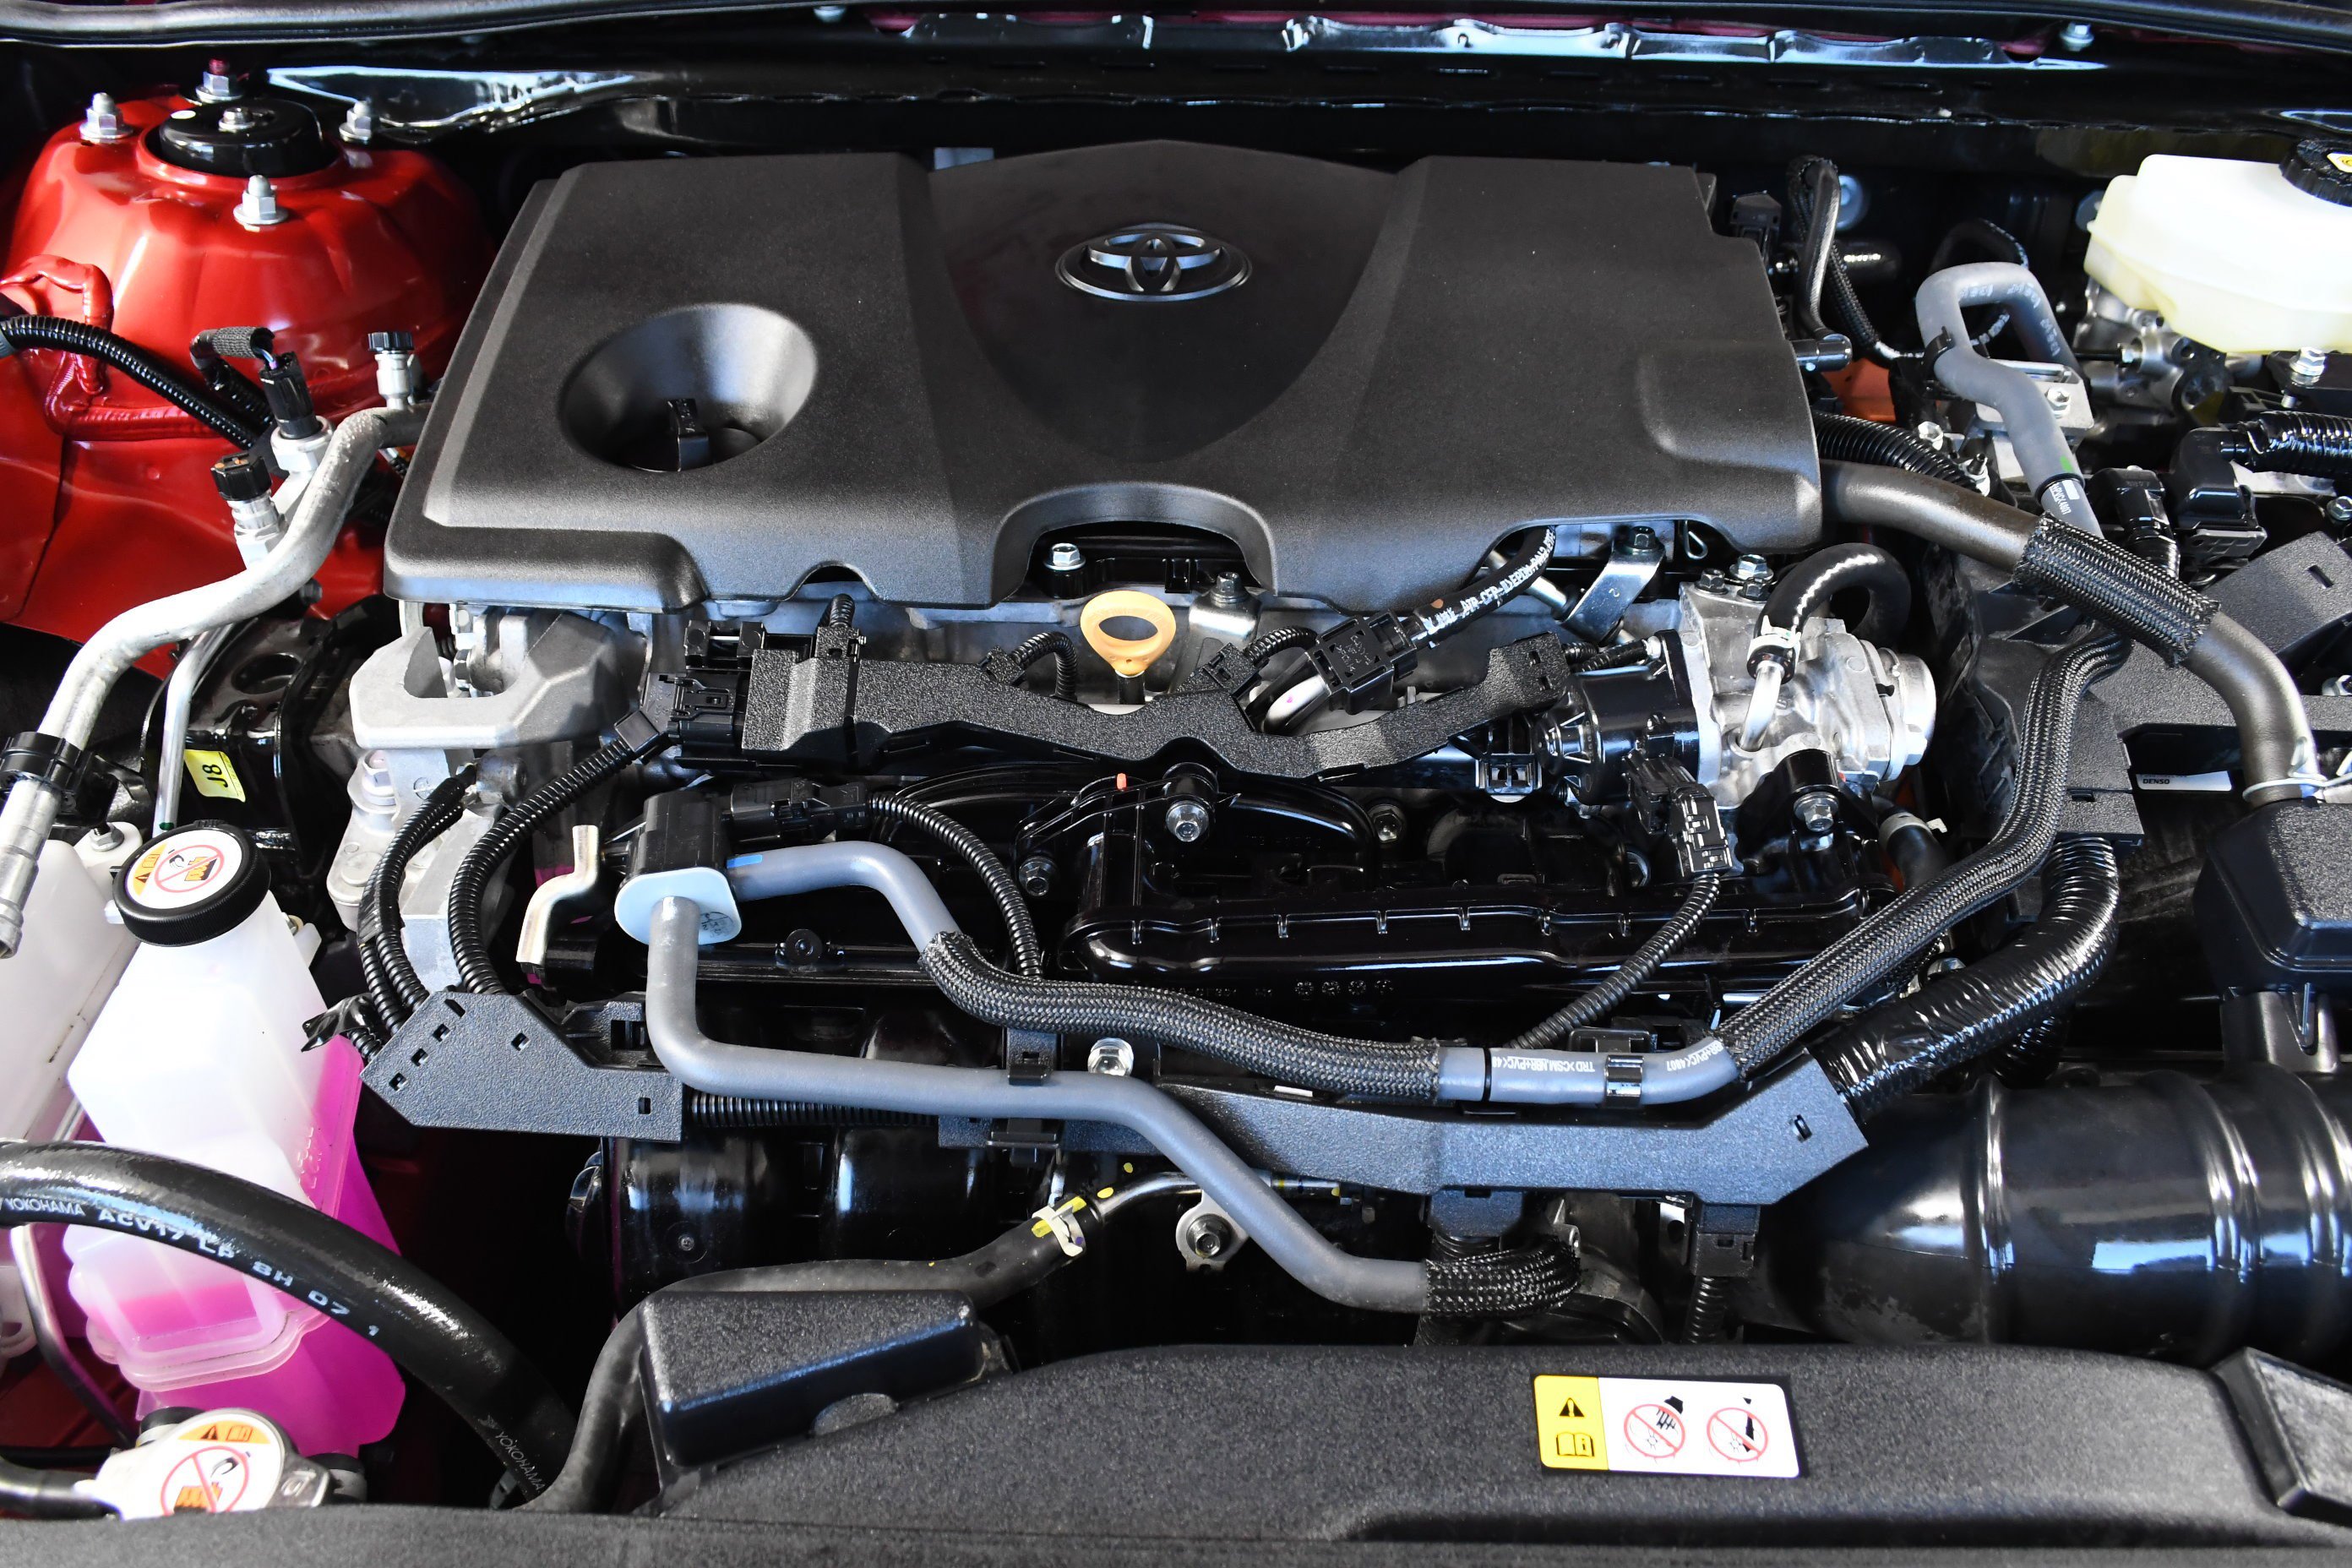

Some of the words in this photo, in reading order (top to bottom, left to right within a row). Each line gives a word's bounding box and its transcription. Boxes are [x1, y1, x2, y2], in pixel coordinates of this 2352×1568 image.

[201, 764, 229, 788] J8
[1575, 1060, 1596, 1073] TRD
[4, 1196, 86, 1217] YOKOHAMA
[495, 1430, 546, 1490] YOKOHAMA
